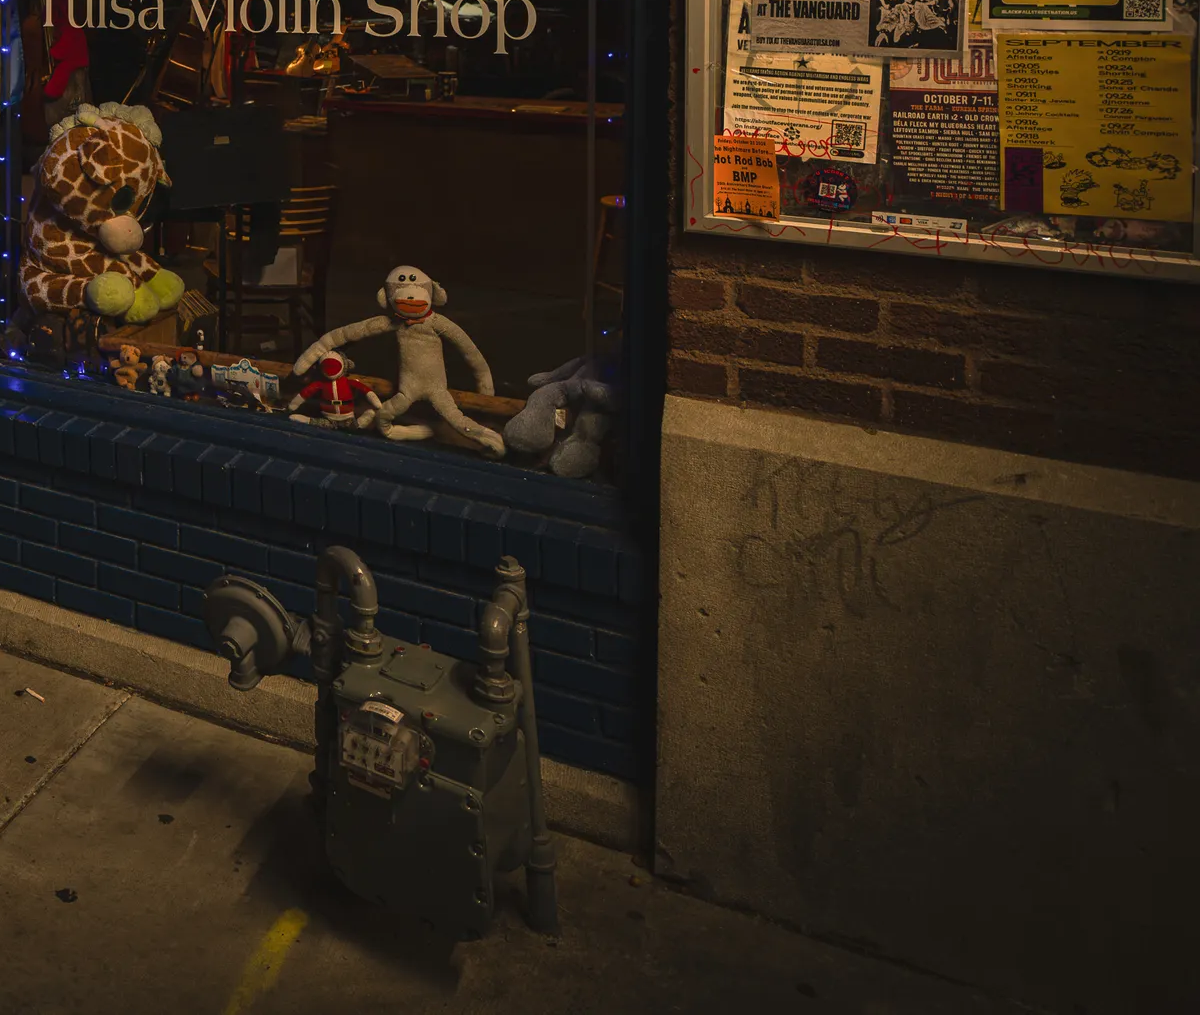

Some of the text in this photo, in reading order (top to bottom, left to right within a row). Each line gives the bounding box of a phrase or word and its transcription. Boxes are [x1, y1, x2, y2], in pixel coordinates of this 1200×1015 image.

[757, 3, 767, 16] AT
[769, 0, 791, 18] THE
[793, 1, 860, 20] VANGUARD
[1006, 39, 1181, 48] SEPTEMBER
[924, 94, 968, 104] OCTOBER
[893, 111, 925, 119] RAILROAD
[927, 112, 949, 120] EARTH
[714, 154, 773, 168] Hot Rod Bob
[732, 170, 757, 183] BMP
